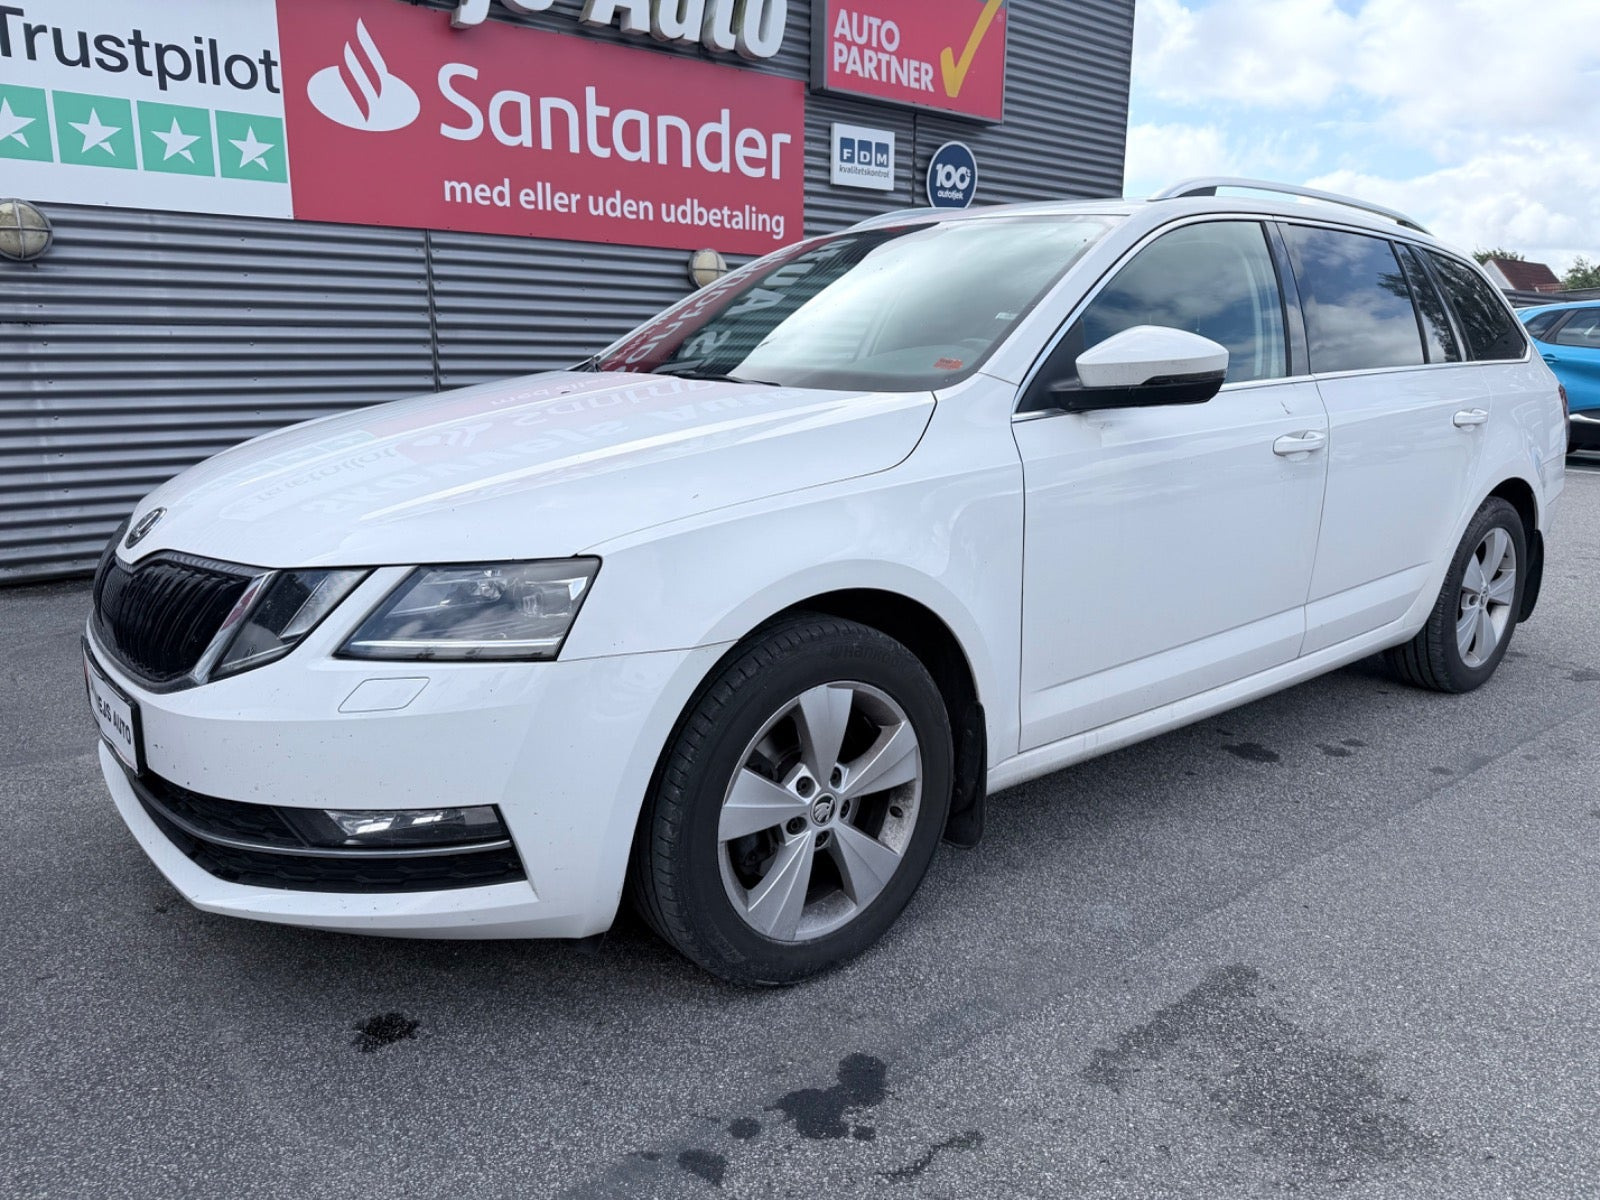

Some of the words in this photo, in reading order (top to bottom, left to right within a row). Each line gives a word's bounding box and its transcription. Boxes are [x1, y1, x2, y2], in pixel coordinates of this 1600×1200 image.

[0, 5, 281, 94] Trustpilot
[834, 9, 900, 52] AUTO
[833, 42, 935, 92] PARTNER
[437, 62, 792, 180] Santander
[444, 178, 511, 207] med
[519, 182, 581, 213] eller
[588, 190, 654, 221] uden
[661, 197, 785, 239] udbetaling
[113, 710, 131, 745] AUTO
